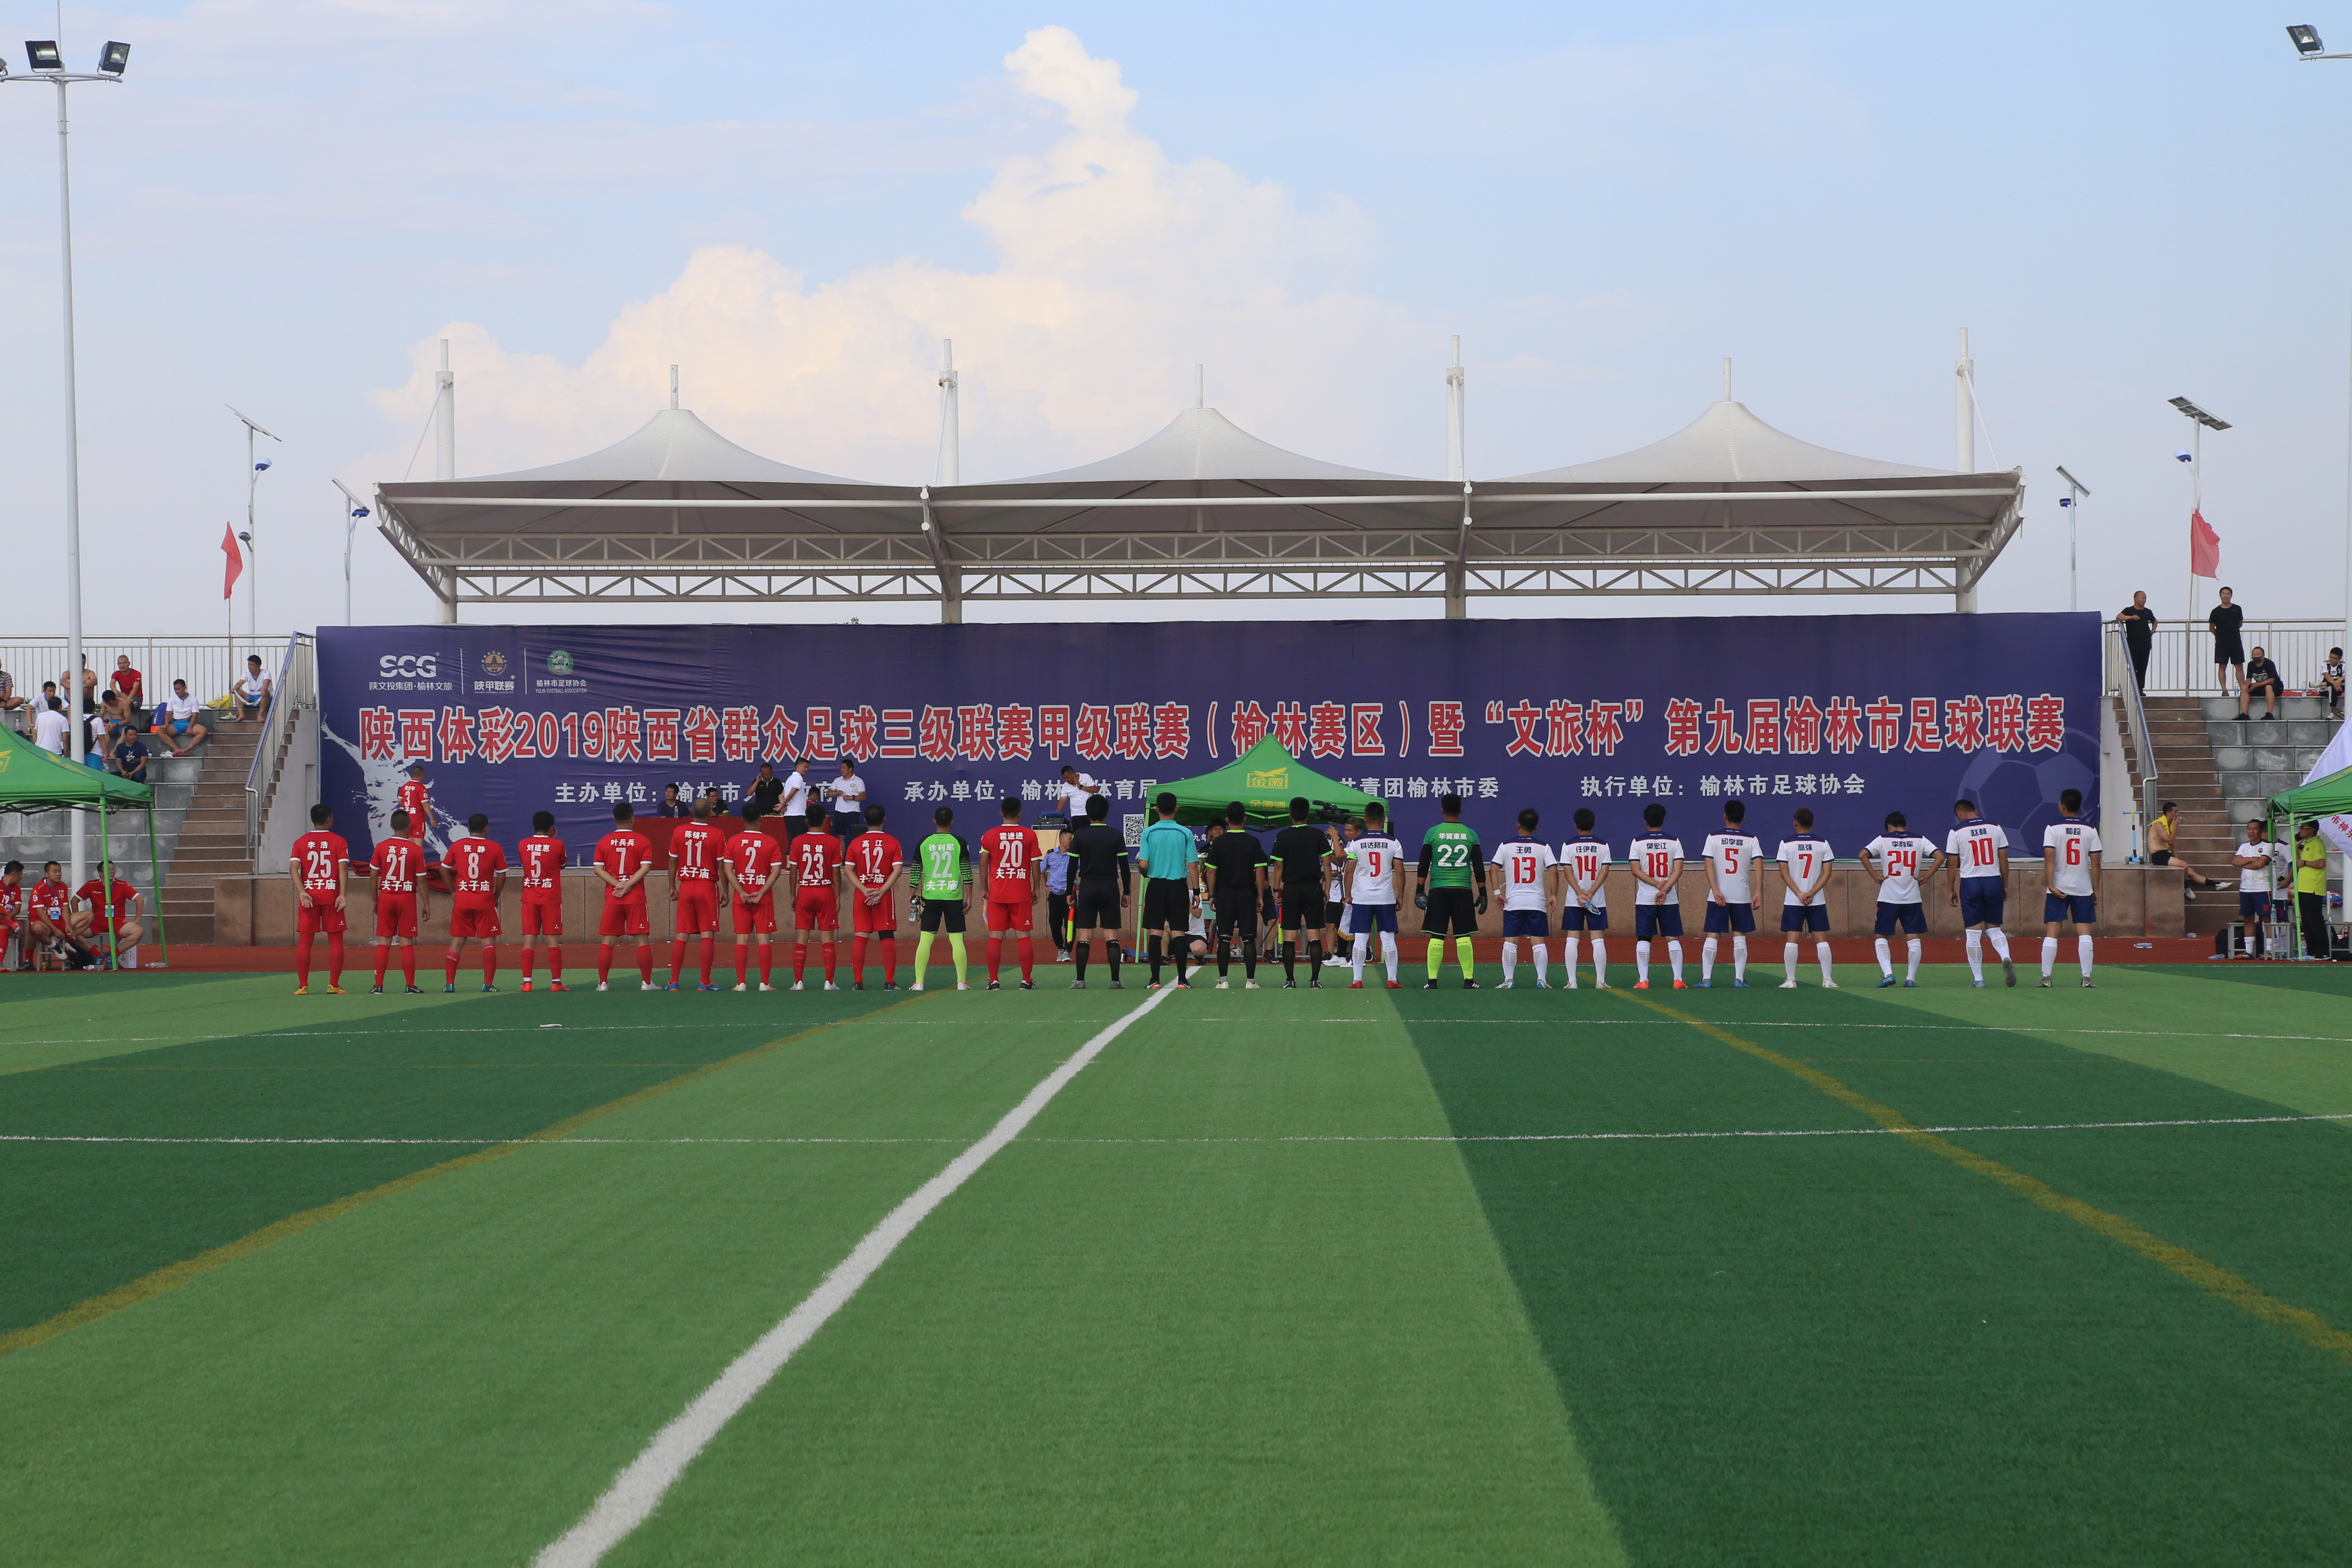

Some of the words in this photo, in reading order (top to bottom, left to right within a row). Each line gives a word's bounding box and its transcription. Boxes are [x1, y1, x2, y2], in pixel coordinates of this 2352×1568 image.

[380, 655, 437, 678] SCG
[474, 681, 514, 691] 陕甲联赛
[404, 790, 410, 807] 3
[307, 841, 328, 849] 李浩
[684, 830, 707, 839] 陈锦平
[741, 839, 762, 848] 严鹏
[389, 845, 408, 854] 高杰
[463, 845, 485, 853] 张静
[685, 839, 702, 867] 11
[803, 844, 823, 853] 陶健
[928, 843, 954, 851] 徐利军
[999, 840, 1023, 867] 20
[1437, 844, 1468, 867] 22
[1516, 846, 1532, 854] 王勇
[1969, 838, 1994, 866] 10
[2066, 839, 2080, 865] 6
[307, 851, 331, 879] 25
[386, 854, 406, 881] 21
[468, 852, 479, 879] 8
[531, 851, 541, 878] 5
[616, 848, 626, 874] 7
[680, 865, 709, 879] 夫子庙
[745, 847, 756, 873] 2
[802, 852, 824, 879] 23
[862, 847, 883, 874] 12
[930, 851, 953, 878] 22
[1369, 851, 1381, 877] 9
[1512, 857, 1536, 884] 13
[1575, 855, 1598, 881] 14
[1646, 852, 1668, 878] 18
[1725, 848, 1739, 874] 5
[1799, 854, 1813, 879] 7
[1887, 851, 1916, 876] 24
[304, 879, 336, 889] 夫子庙
[382, 879, 412, 891] 夫子庙
[738, 873, 766, 885] 夫子庙
[927, 880, 958, 890] 夫子庙
[996, 867, 1026, 879] 夫子庙
[459, 880, 489, 891] 夫子庙
[1, 894, 9, 904] 19
